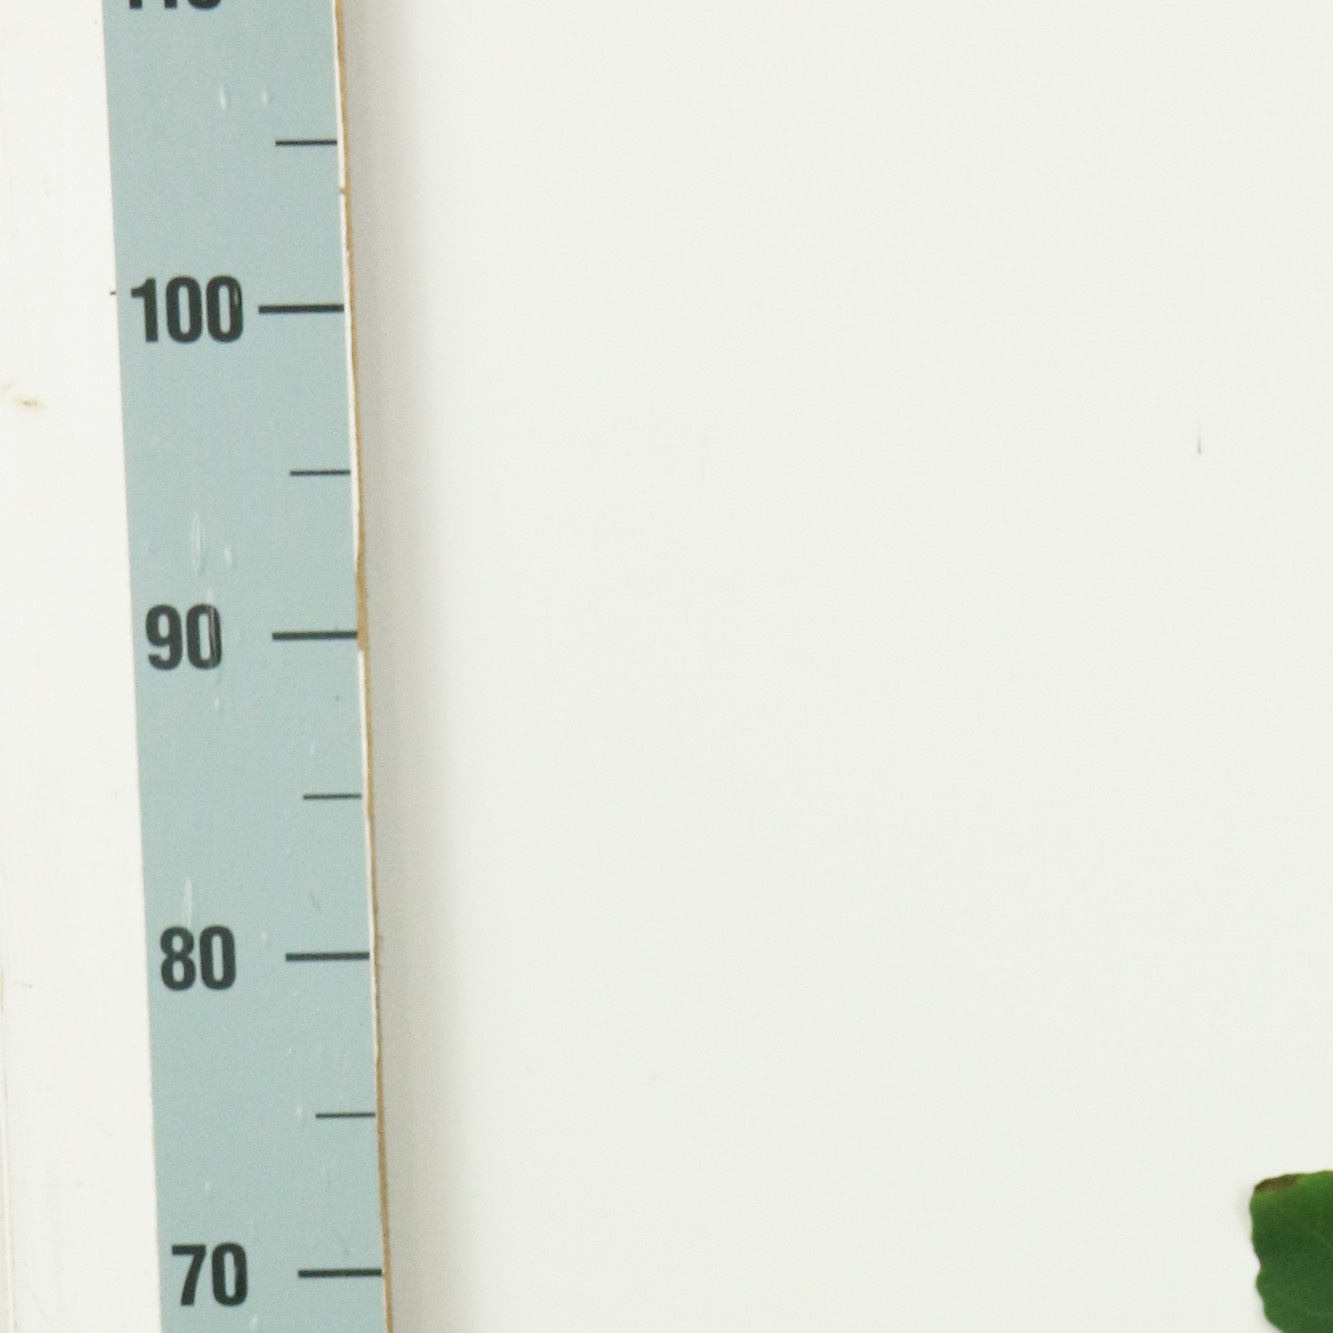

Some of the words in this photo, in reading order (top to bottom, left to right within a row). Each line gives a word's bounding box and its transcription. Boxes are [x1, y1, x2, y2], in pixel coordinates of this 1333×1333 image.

[131, 275, 243, 343] 100
[145, 603, 223, 671] 90
[160, 925, 236, 991] 80
[171, 1242, 248, 1306] 70
